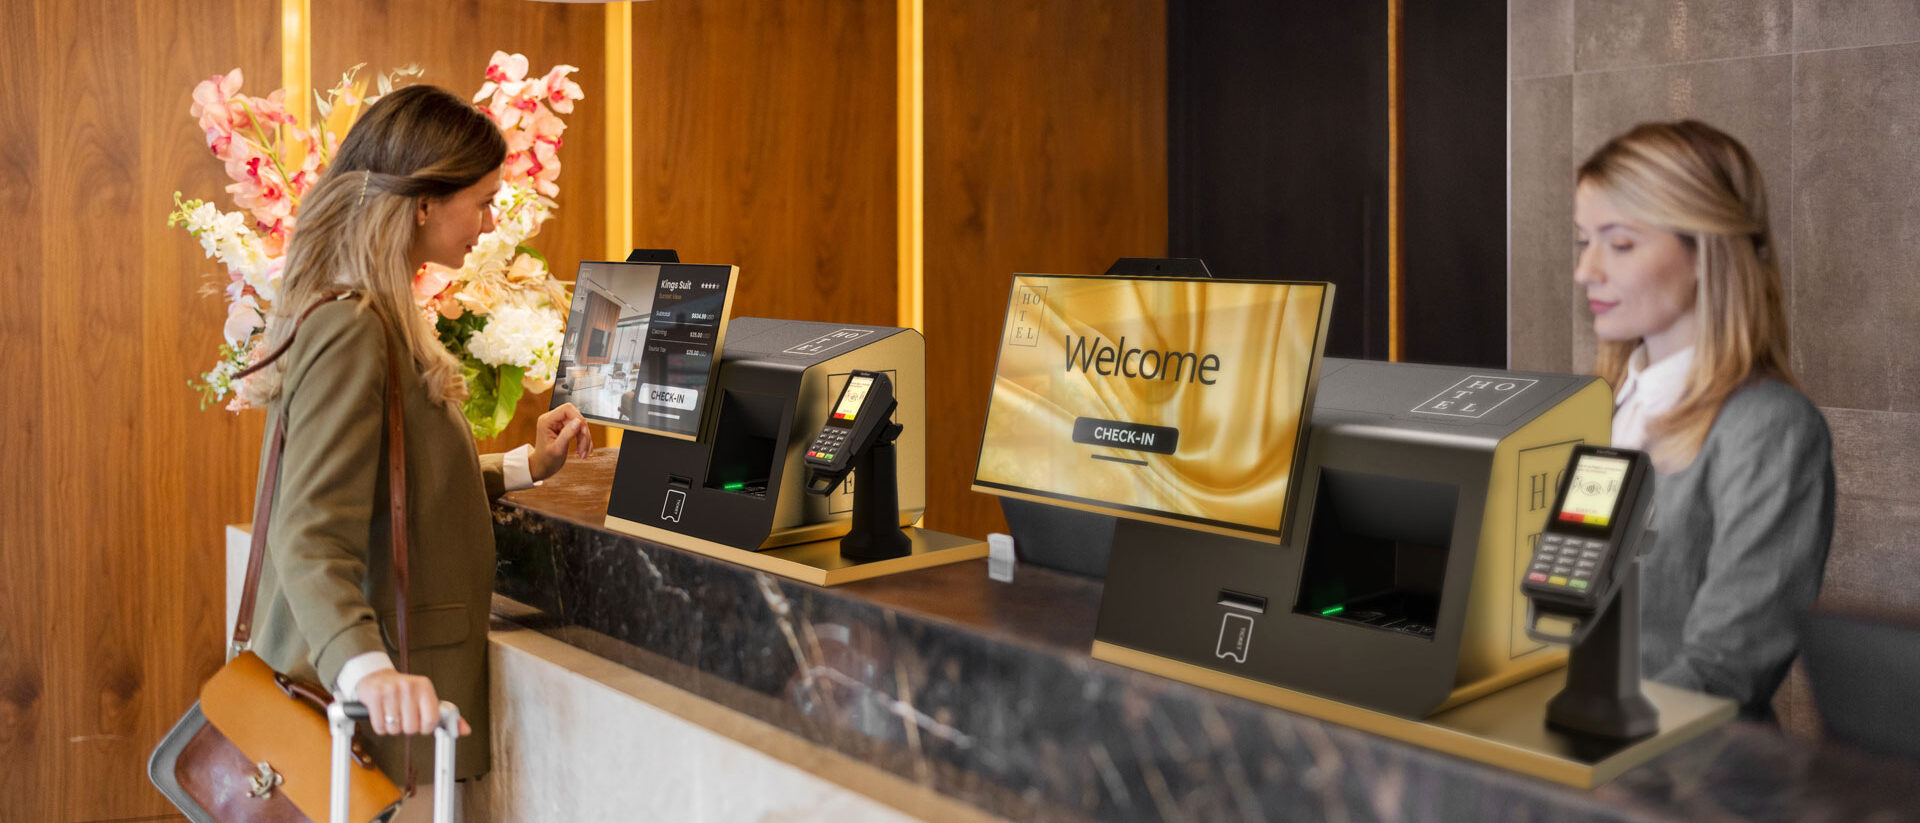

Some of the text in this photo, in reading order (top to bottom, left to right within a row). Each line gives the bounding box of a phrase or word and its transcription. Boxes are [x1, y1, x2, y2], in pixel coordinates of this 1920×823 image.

[661, 280, 692, 292] Kings Suit
[1065, 334, 1221, 386] Welcome
[650, 390, 685, 404] CHECK-IN
[1094, 426, 1156, 446] CHECK-IN
